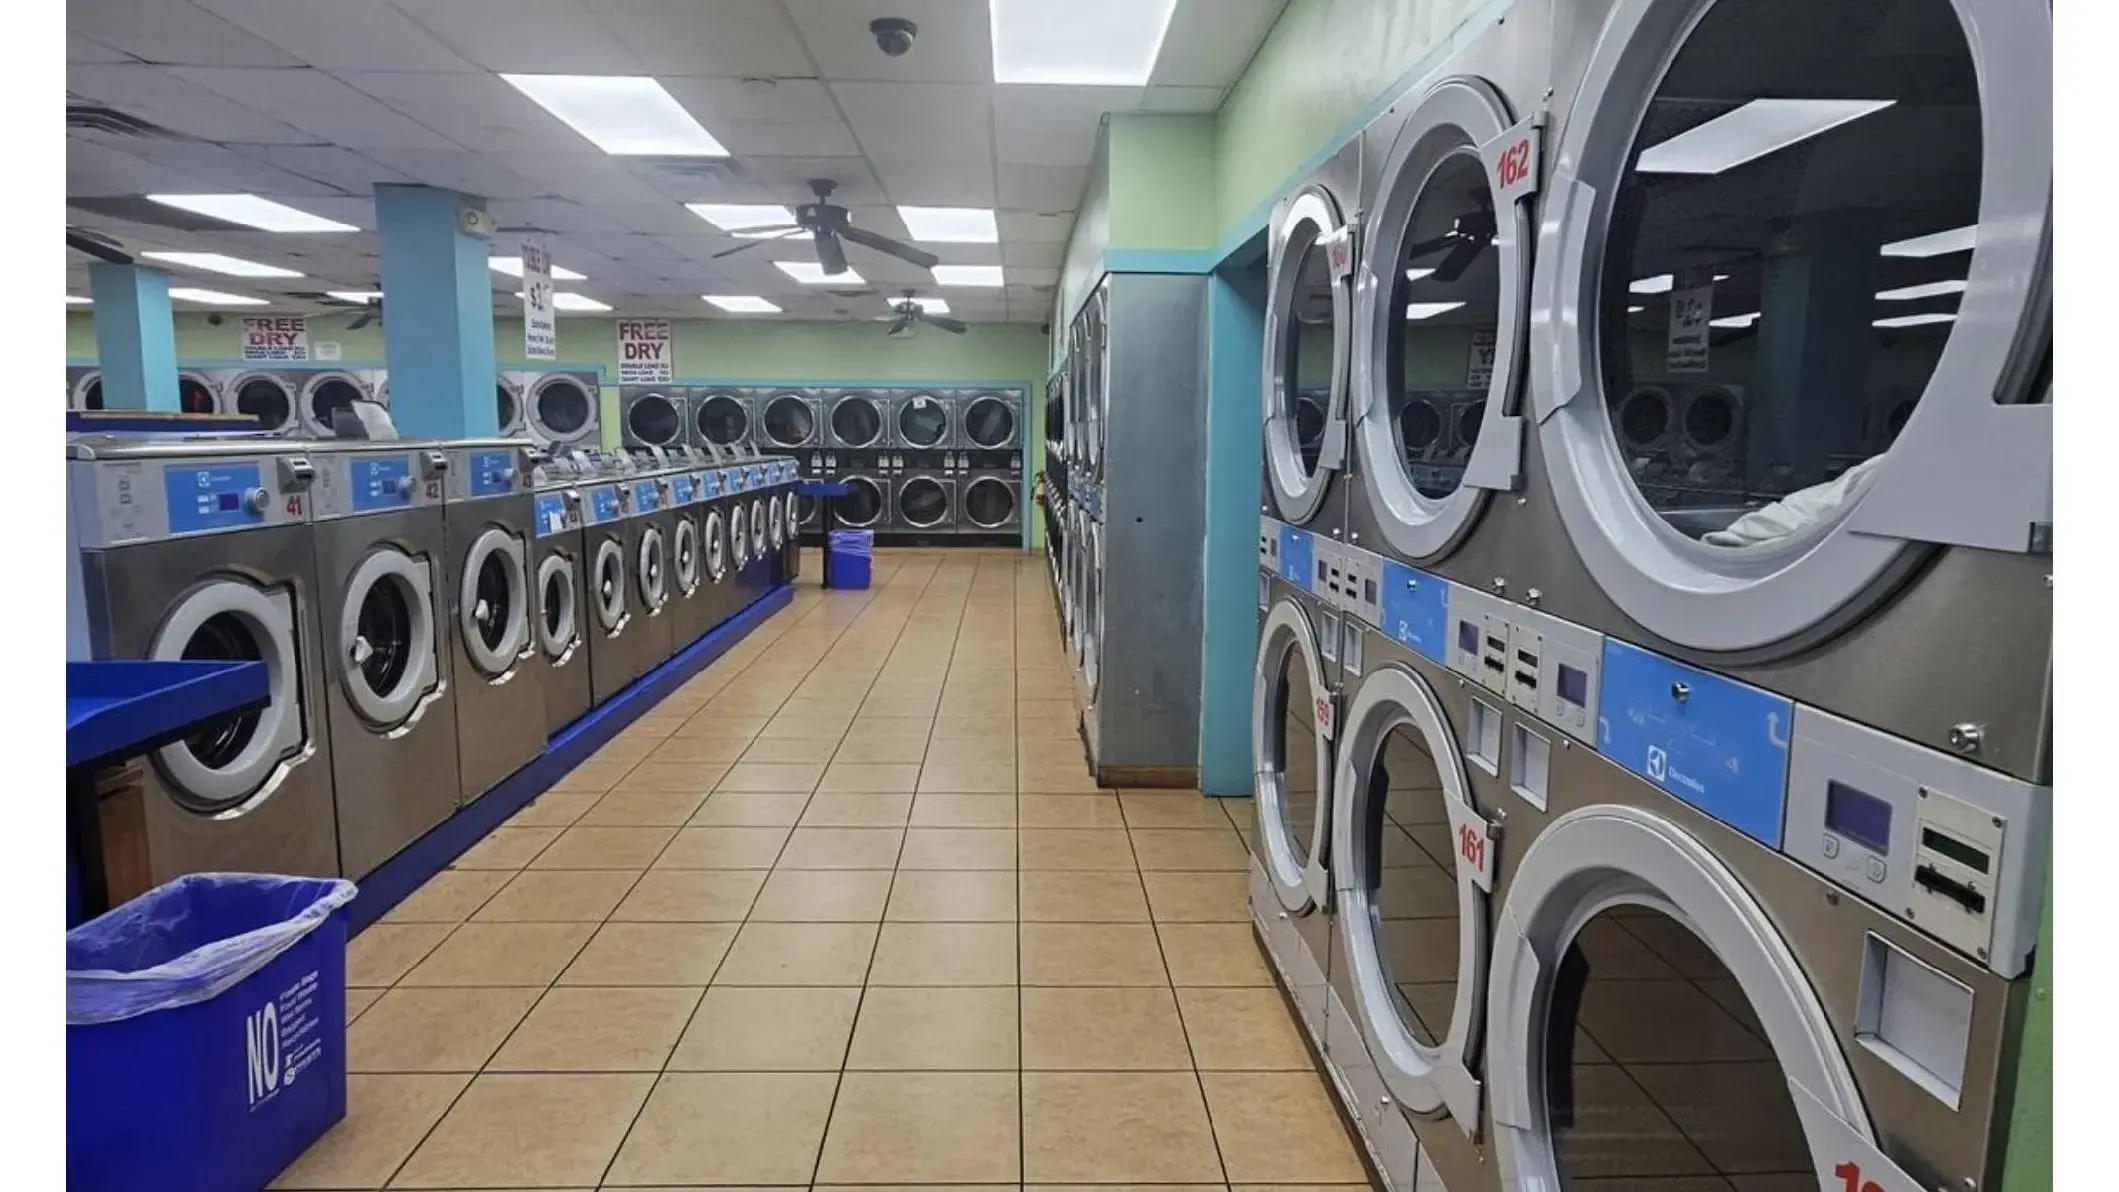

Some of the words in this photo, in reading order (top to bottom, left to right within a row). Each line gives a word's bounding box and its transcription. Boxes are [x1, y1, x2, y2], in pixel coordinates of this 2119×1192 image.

[1497, 139, 1529, 189] 162
[242, 318, 305, 332] FREE
[619, 322, 669, 340] FREE
[249, 332, 298, 346] DRY
[624, 342, 663, 360] DRY
[424, 482, 439, 499] 42
[285, 496, 302, 516] 41
[1460, 823, 1484, 872] 161
[247, 1001, 279, 1104] NO
